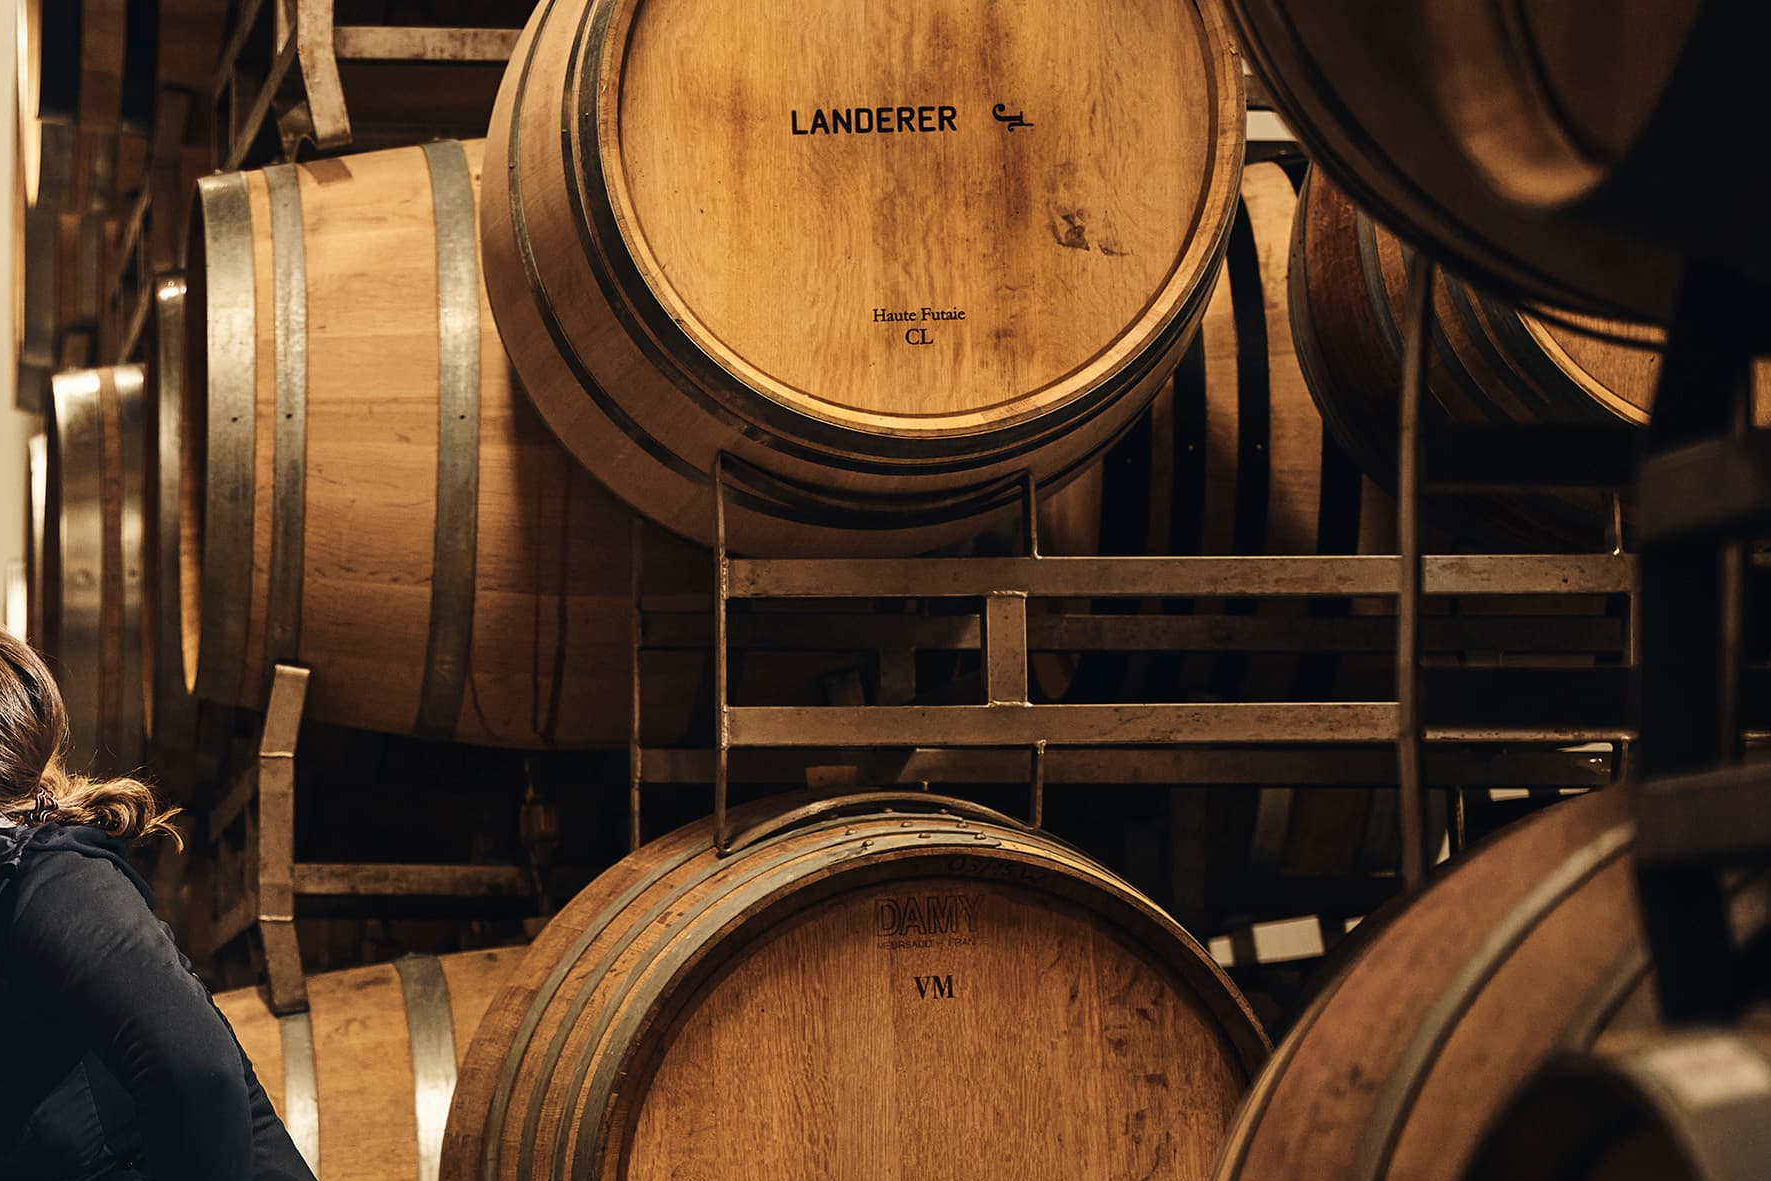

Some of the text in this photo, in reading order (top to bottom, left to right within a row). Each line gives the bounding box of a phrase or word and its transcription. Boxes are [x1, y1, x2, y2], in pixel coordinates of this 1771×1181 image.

[791, 105, 958, 135] LANDERER
[872, 306, 966, 322] Haute Futaie
[904, 328, 934, 345] CL
[875, 895, 984, 937] DAMY
[914, 975, 957, 1000] VM
